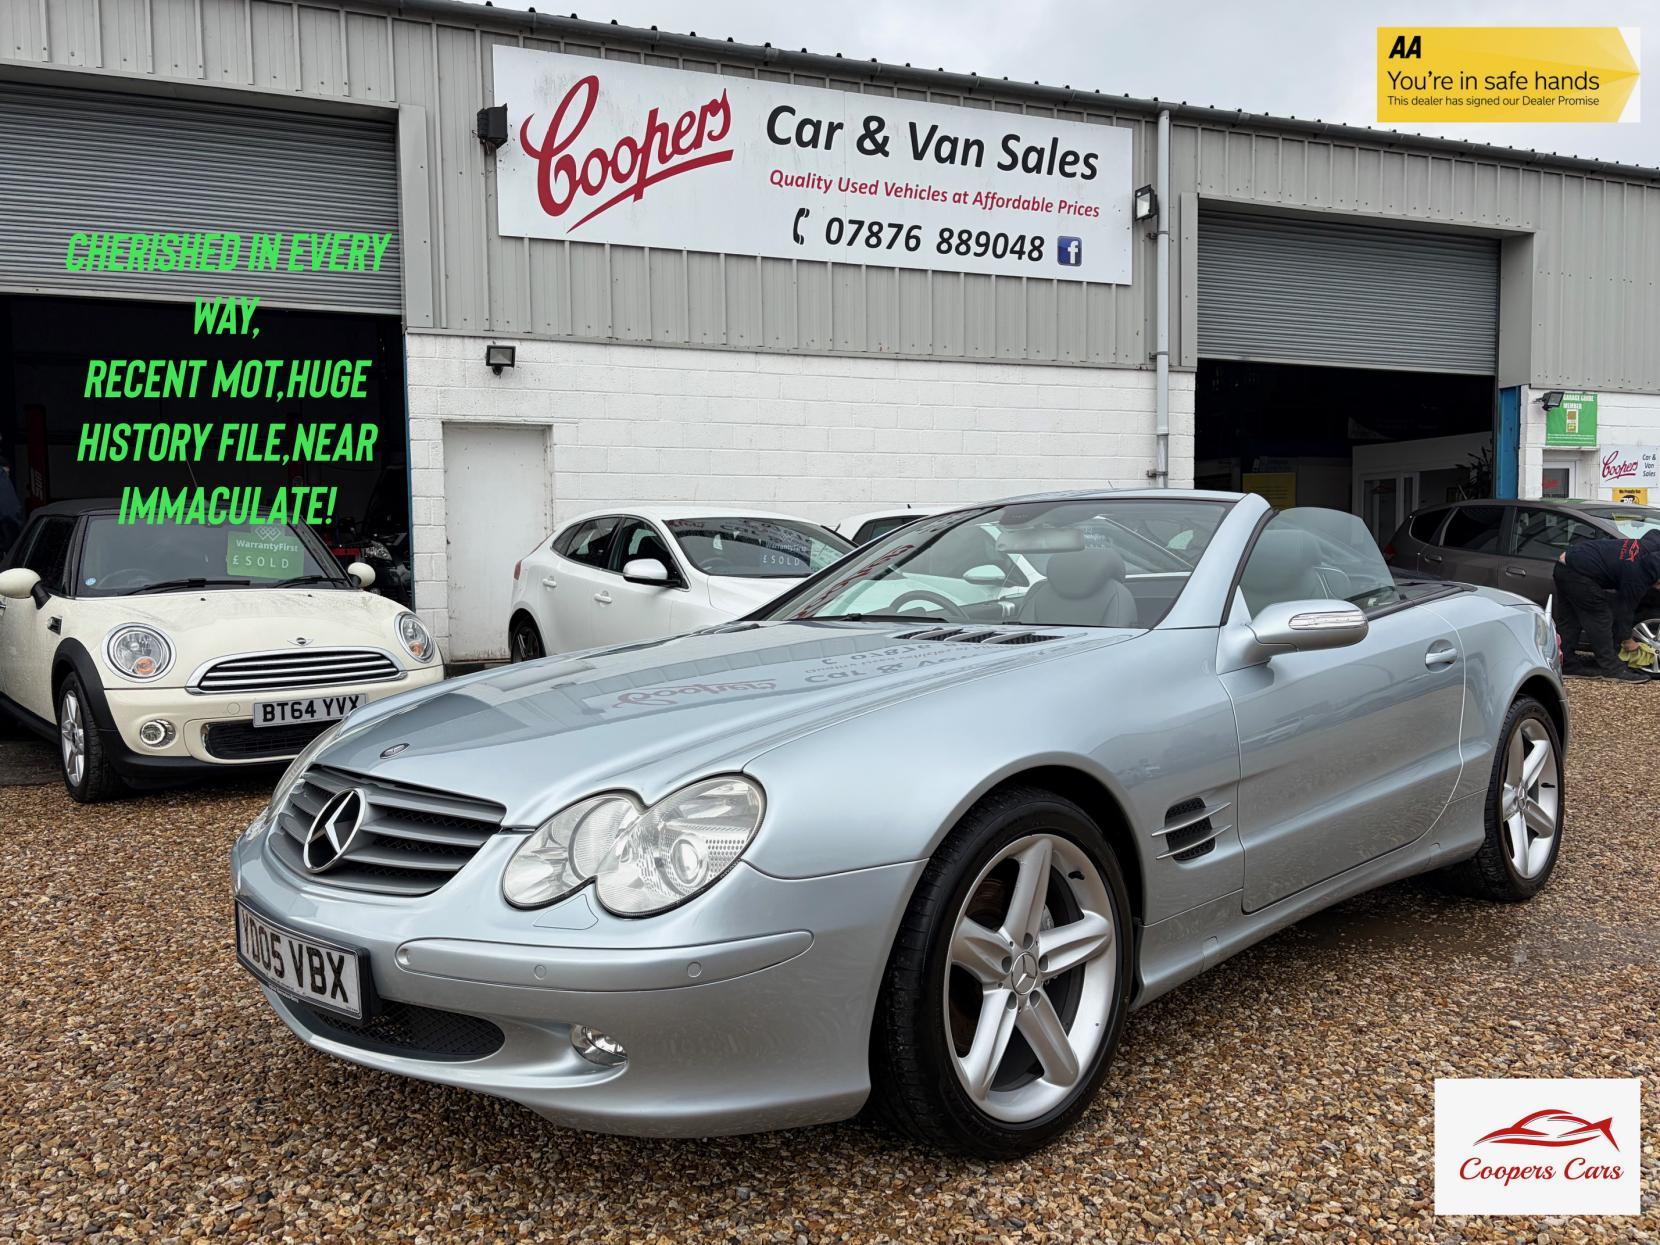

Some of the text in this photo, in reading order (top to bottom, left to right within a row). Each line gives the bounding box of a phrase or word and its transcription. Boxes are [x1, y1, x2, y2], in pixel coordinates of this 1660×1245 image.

[520, 74, 734, 228] Coopers
[766, 105, 1099, 182] Car & Van Sales
[770, 169, 1101, 218] Quality Used Vehicles at Affordable Prices
[825, 216, 1045, 262] 07876 889048
[1602, 450, 1639, 481] Coopers
[235, 539, 299, 553] WarrantyFirst
[262, 695, 360, 722] BT64 YVX
[240, 908, 349, 1003] YD05 VBX
